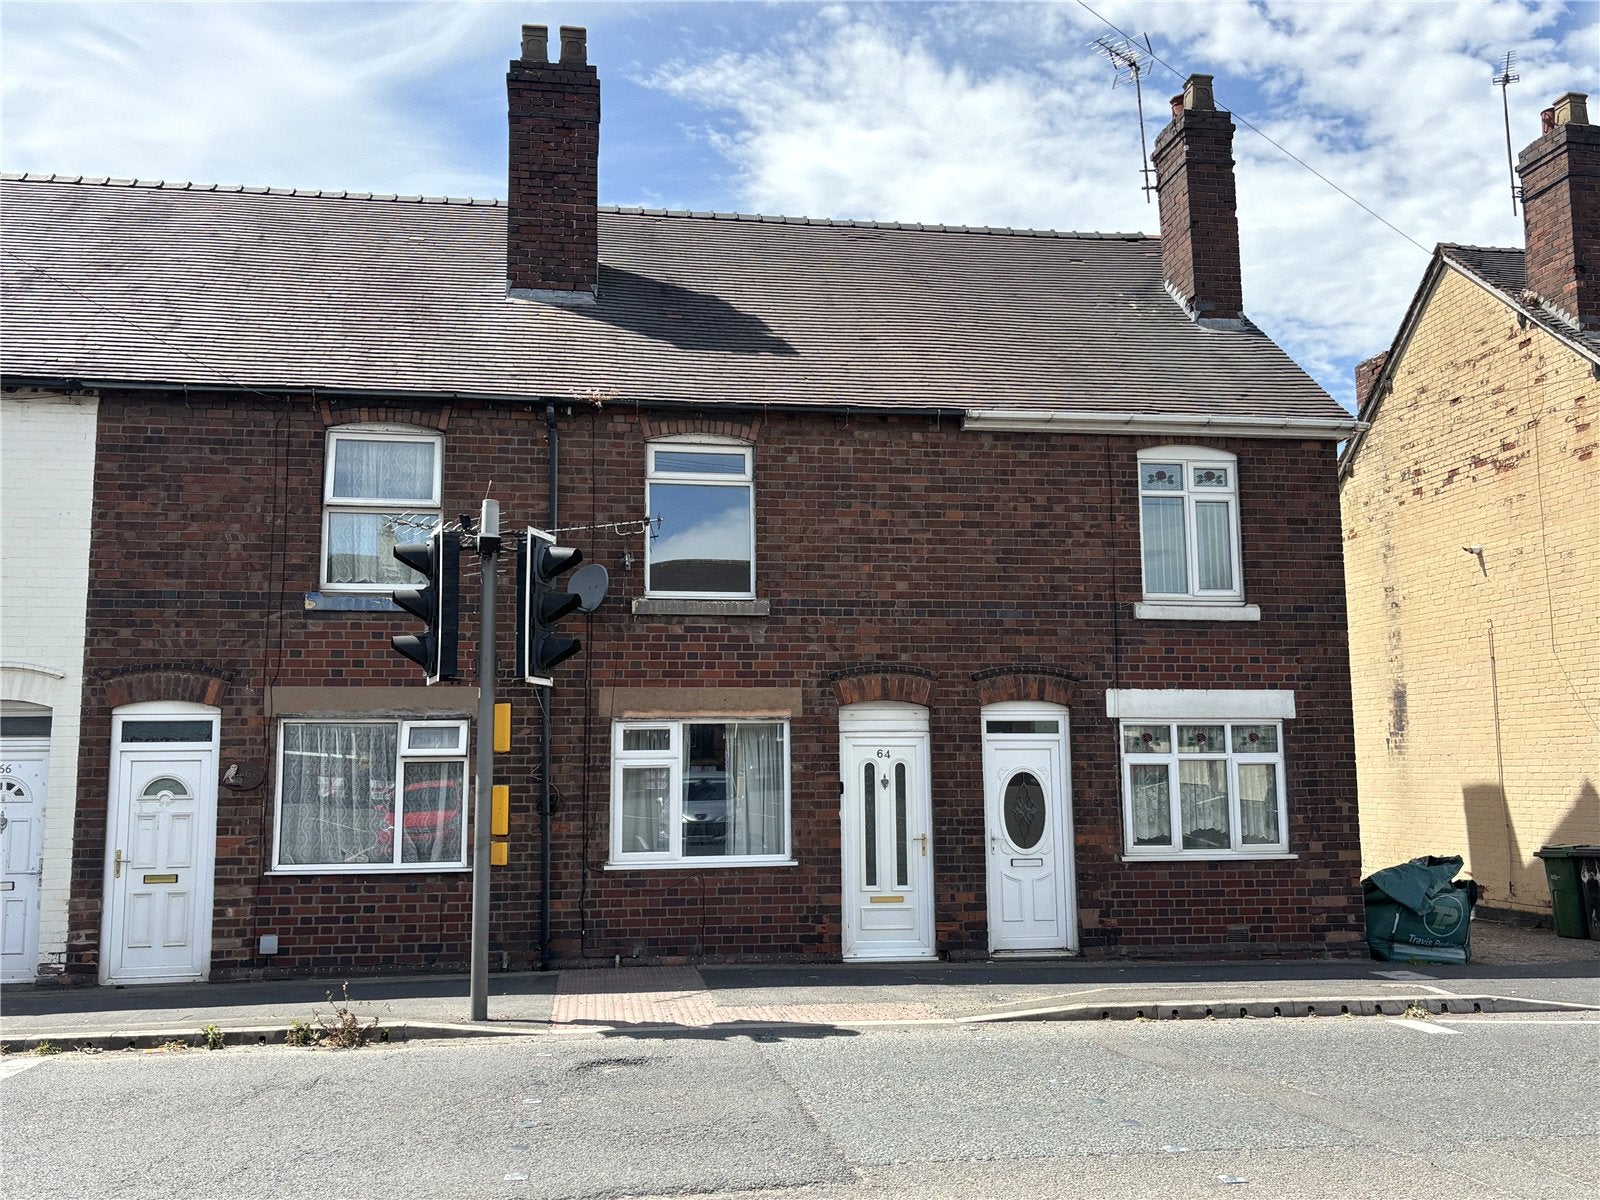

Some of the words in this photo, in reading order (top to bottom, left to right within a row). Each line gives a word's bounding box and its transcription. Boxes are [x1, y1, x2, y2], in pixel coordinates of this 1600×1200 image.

[877, 749, 890, 758] 64
[1432, 905, 1459, 929] TP
[1409, 933, 1433, 946] Travis
